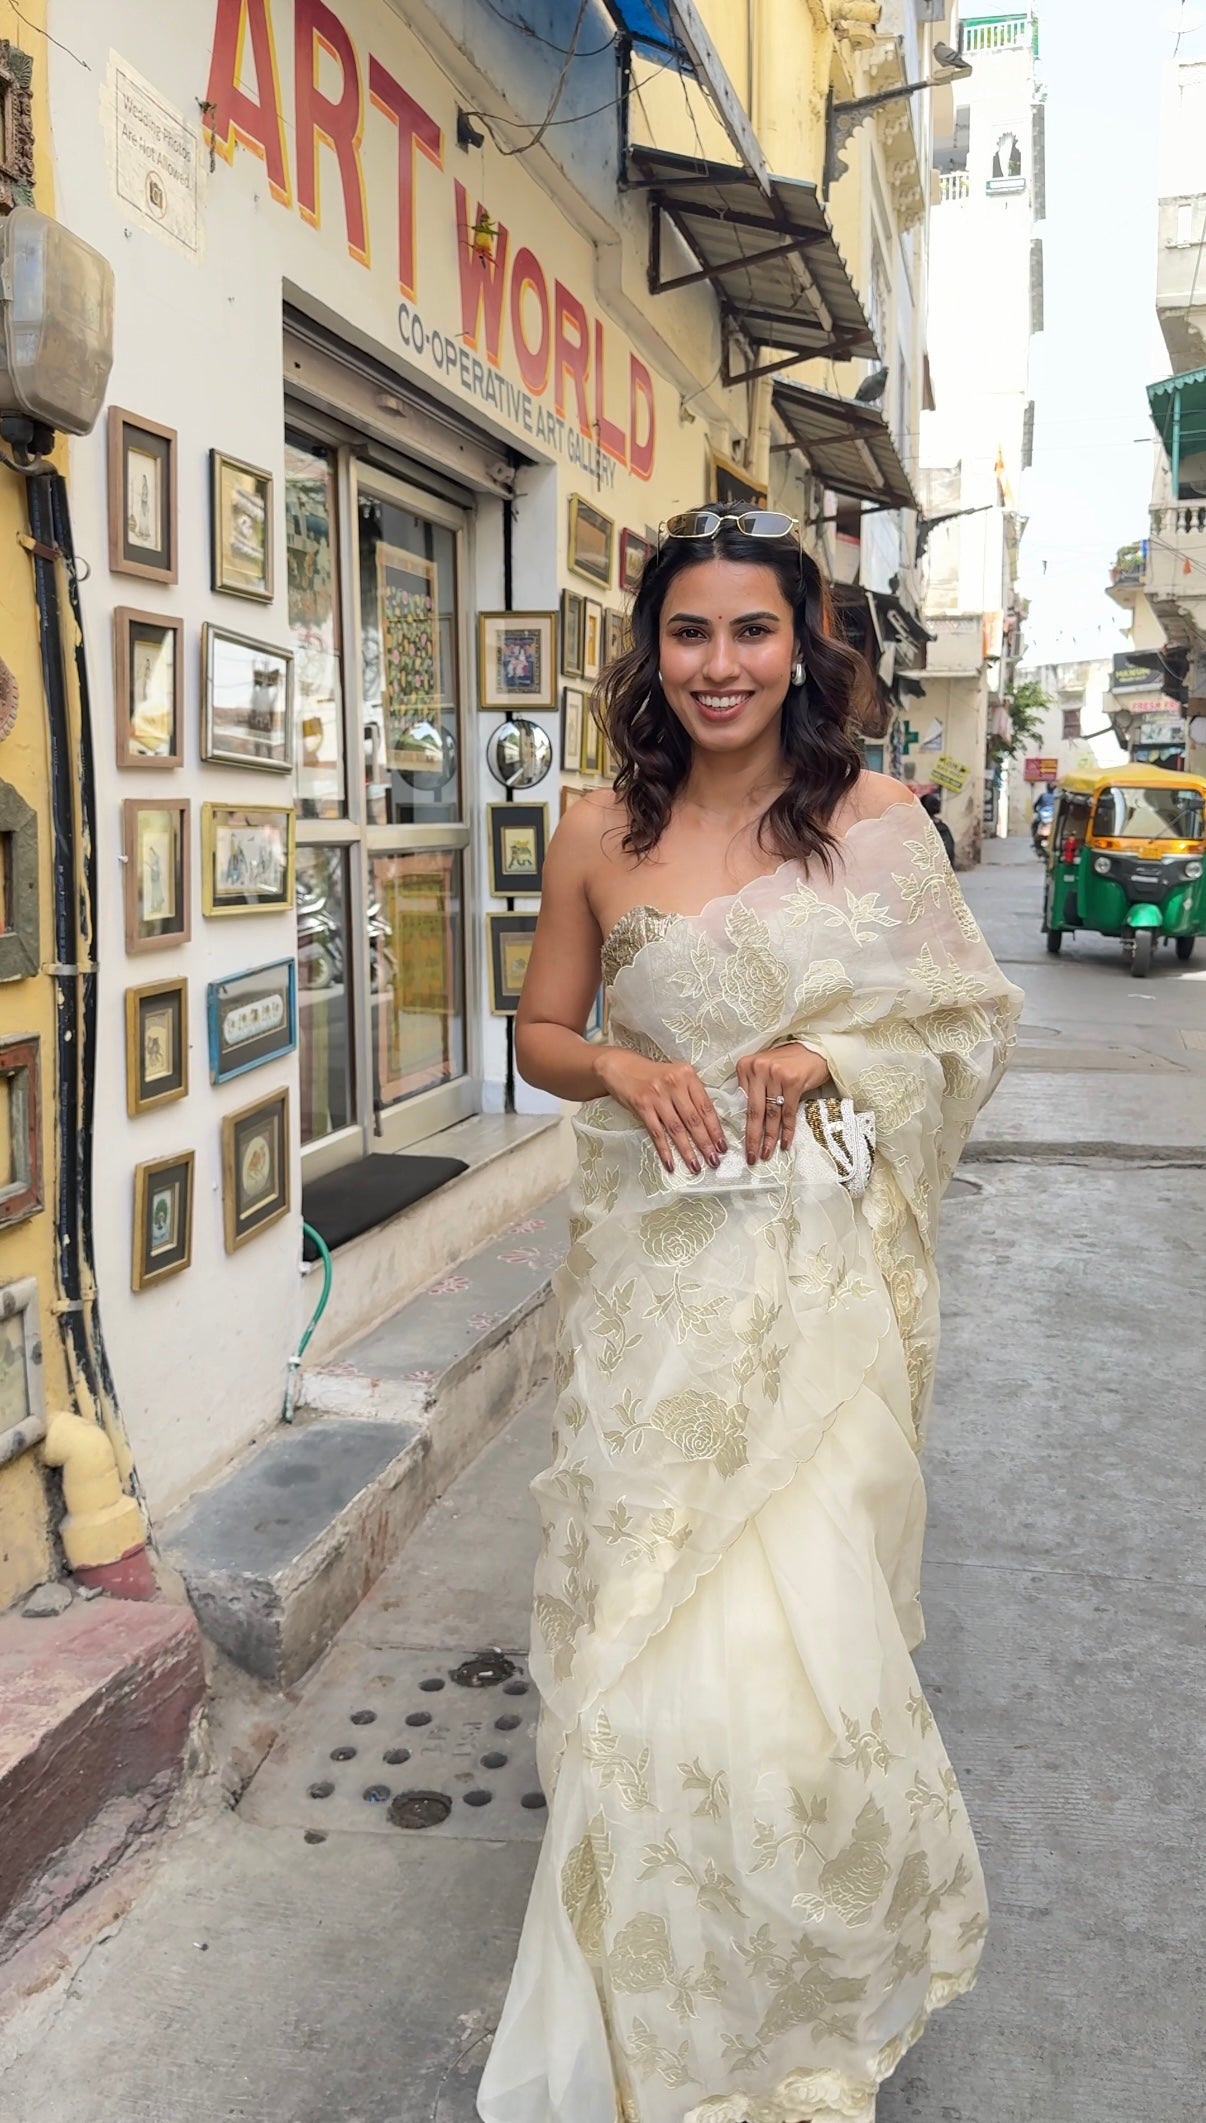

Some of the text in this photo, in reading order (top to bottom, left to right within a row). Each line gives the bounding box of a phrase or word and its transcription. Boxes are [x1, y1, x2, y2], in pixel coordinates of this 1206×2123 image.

[121, 122, 138, 148] Are
[139, 136, 156, 164] Not
[122, 92, 192, 163] Wedding Photos
[201, 0, 656, 482] ART WORLD
[398, 302, 617, 489] CO-OPERATIVE ART GALLERY
